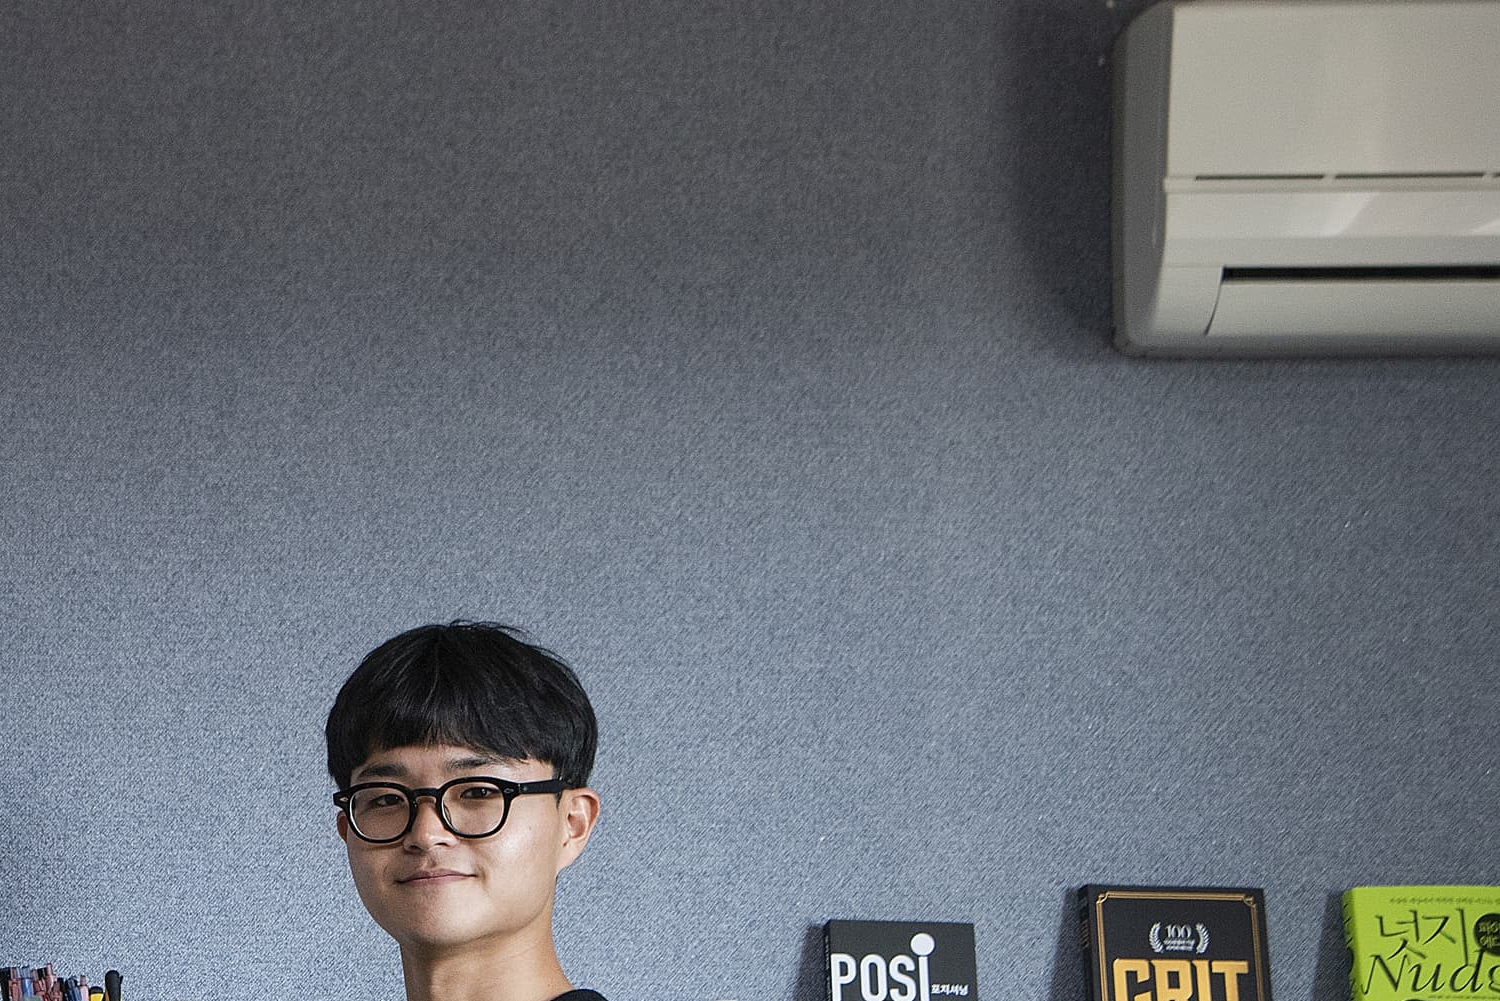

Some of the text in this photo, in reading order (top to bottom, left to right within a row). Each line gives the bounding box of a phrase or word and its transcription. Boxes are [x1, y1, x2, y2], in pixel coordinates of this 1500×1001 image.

[1164, 924, 1192, 939] 100
[1375, 907, 1469, 965] 넛지
[931, 983, 970, 996] 포지셔닝
